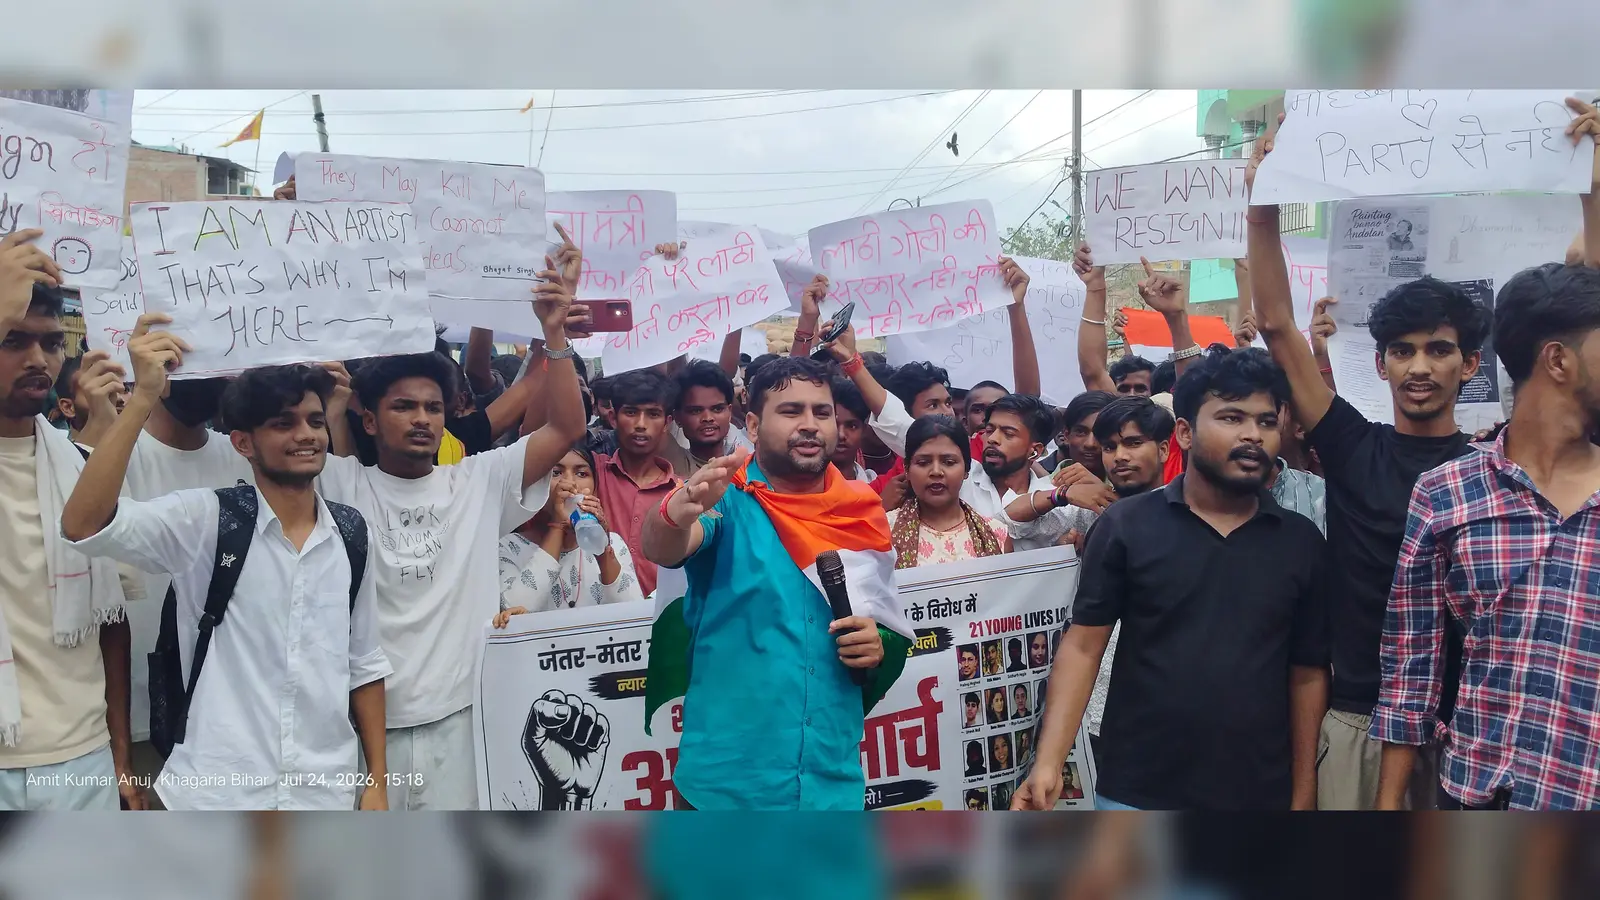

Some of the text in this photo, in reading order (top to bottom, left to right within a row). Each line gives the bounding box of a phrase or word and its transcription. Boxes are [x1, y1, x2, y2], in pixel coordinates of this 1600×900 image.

[1316, 131, 1434, 181] PARTY
[316, 160, 530, 209] They May Kill Me
[1095, 165, 1247, 213] WE WANT
[149, 205, 412, 256] I AM AN ARTIST
[430, 206, 505, 235] Cannot
[1351, 208, 1392, 222] Painting
[820, 208, 986, 270] लाठी गोली की
[1344, 228, 1385, 240] Andolan
[483, 265, 537, 276] Bhagat Singh
[697, 231, 755, 277] लाठी
[158, 259, 266, 308] THAT'S
[362, 256, 408, 292] I'M
[91, 291, 137, 315] Said
[210, 304, 319, 357] HERE
[398, 530, 433, 551] MOM
[413, 538, 442, 558] CAN
[400, 562, 436, 584] FLY
[537, 636, 642, 672] जंतर-मंतर
[911, 602, 924, 622] के
[927, 597, 962, 620] विरोध
[965, 593, 978, 613] में
[969, 620, 983, 638] 21
[985, 615, 1022, 636] YOUNG
[1024, 609, 1053, 628] LIVES
